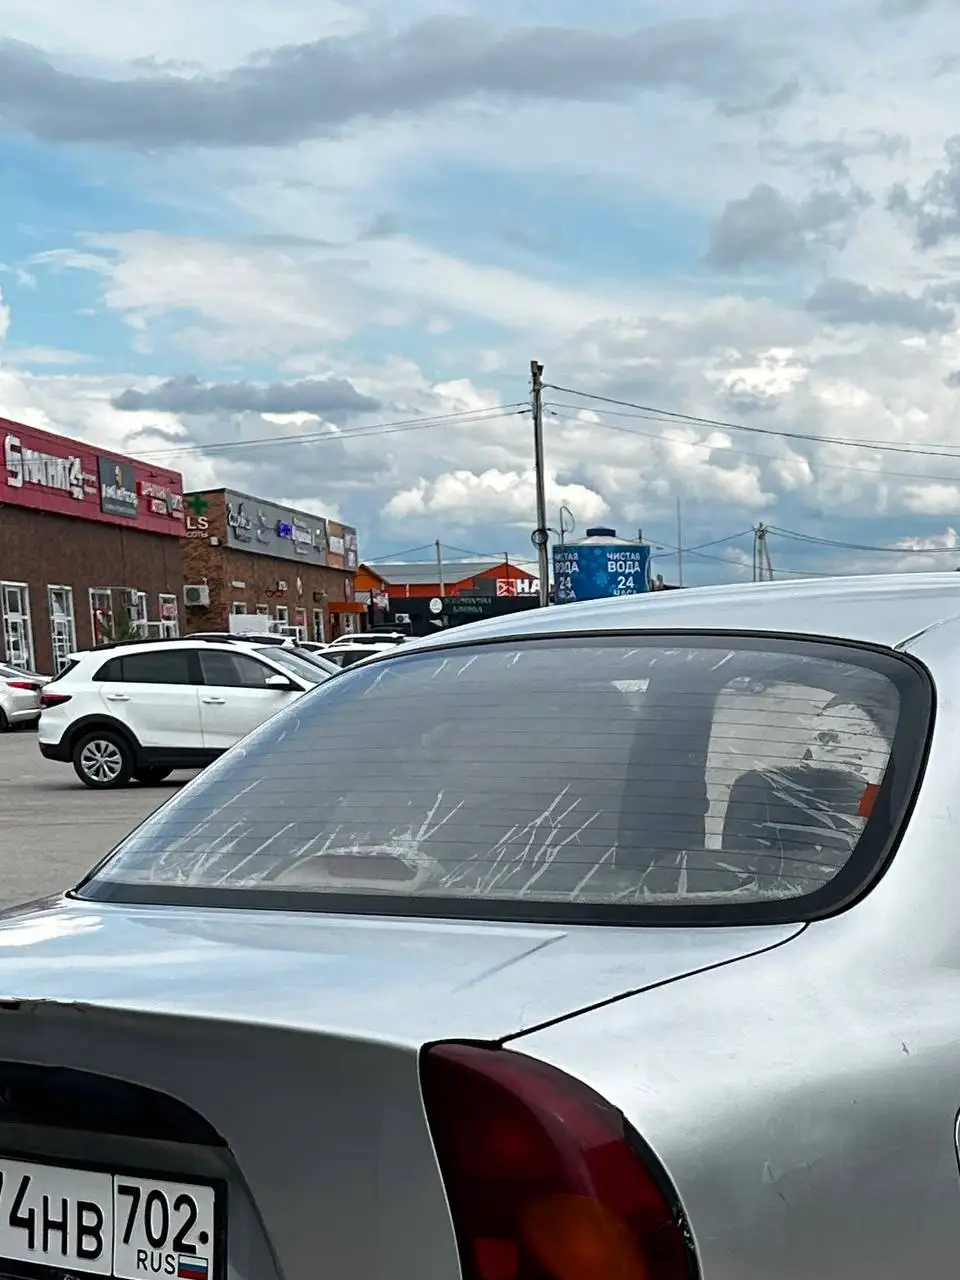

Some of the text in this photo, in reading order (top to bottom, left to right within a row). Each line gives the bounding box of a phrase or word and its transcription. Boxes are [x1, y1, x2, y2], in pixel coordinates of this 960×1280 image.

[606, 552, 640, 561] ЧИСТАЯ
[607, 561, 641, 575] ВОДА
[560, 576, 573, 589] 24
[617, 576, 635, 589] 24
[0, 1171, 198, 1260] 4НВ 702
[136, 1249, 176, 1275] RUS
